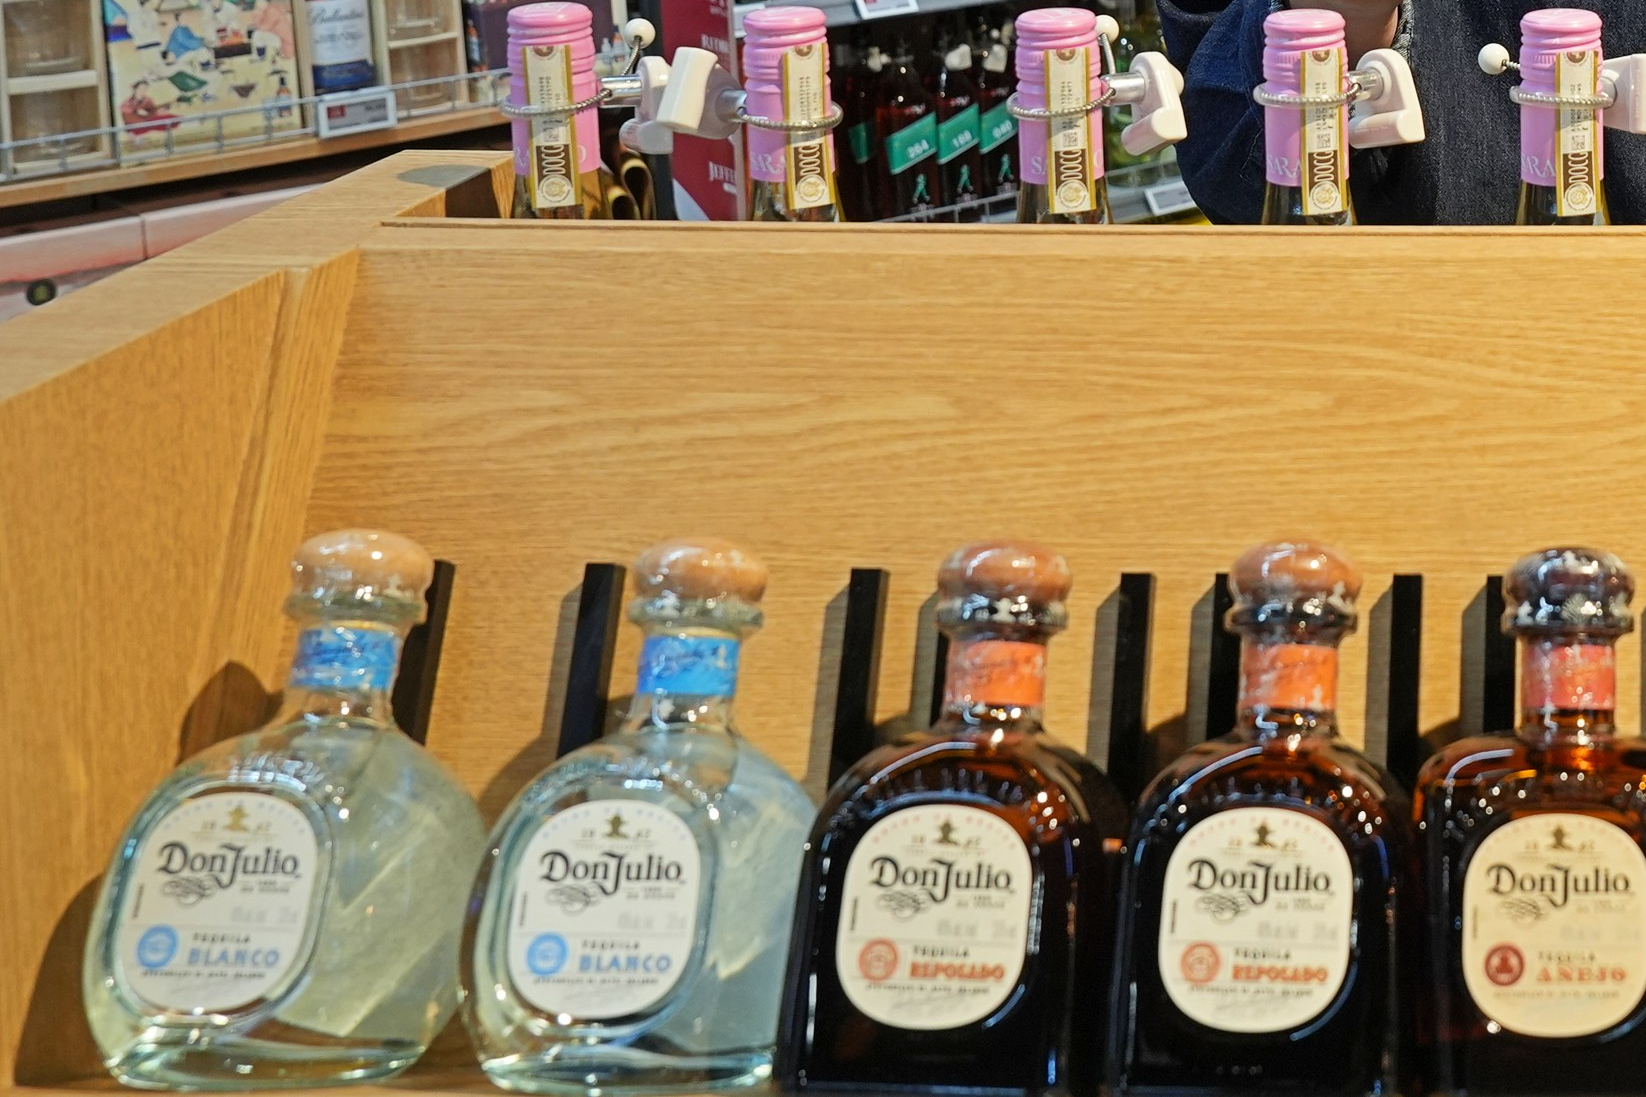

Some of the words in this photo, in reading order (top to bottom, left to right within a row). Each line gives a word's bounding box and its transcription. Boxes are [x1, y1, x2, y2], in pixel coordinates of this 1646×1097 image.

[187, 948, 280, 967] BLANCO
[579, 954, 673, 972] BLANCO
[909, 961, 1005, 982] REPOSADO
[1232, 964, 1329, 983] REPOSADO
